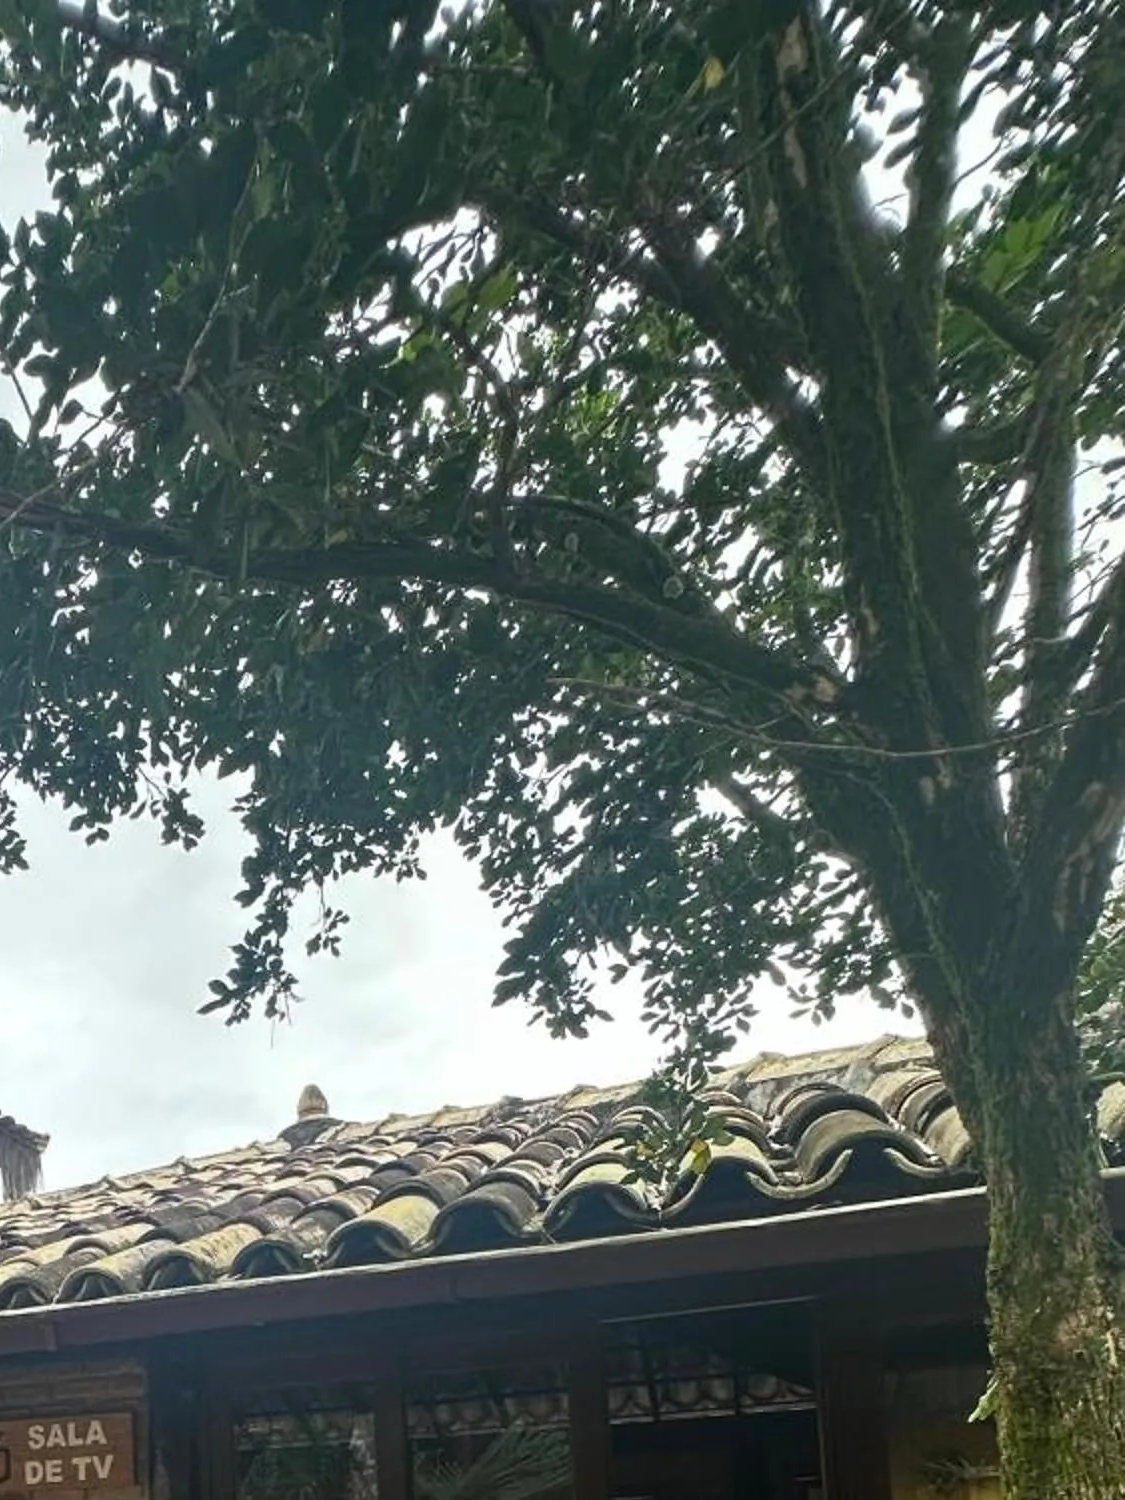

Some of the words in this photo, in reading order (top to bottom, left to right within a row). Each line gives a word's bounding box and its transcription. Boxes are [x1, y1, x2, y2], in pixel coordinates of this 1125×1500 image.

[28, 1420, 107, 1449] SALA
[25, 1459, 63, 1484] DE
[72, 1455, 113, 1480] TV
